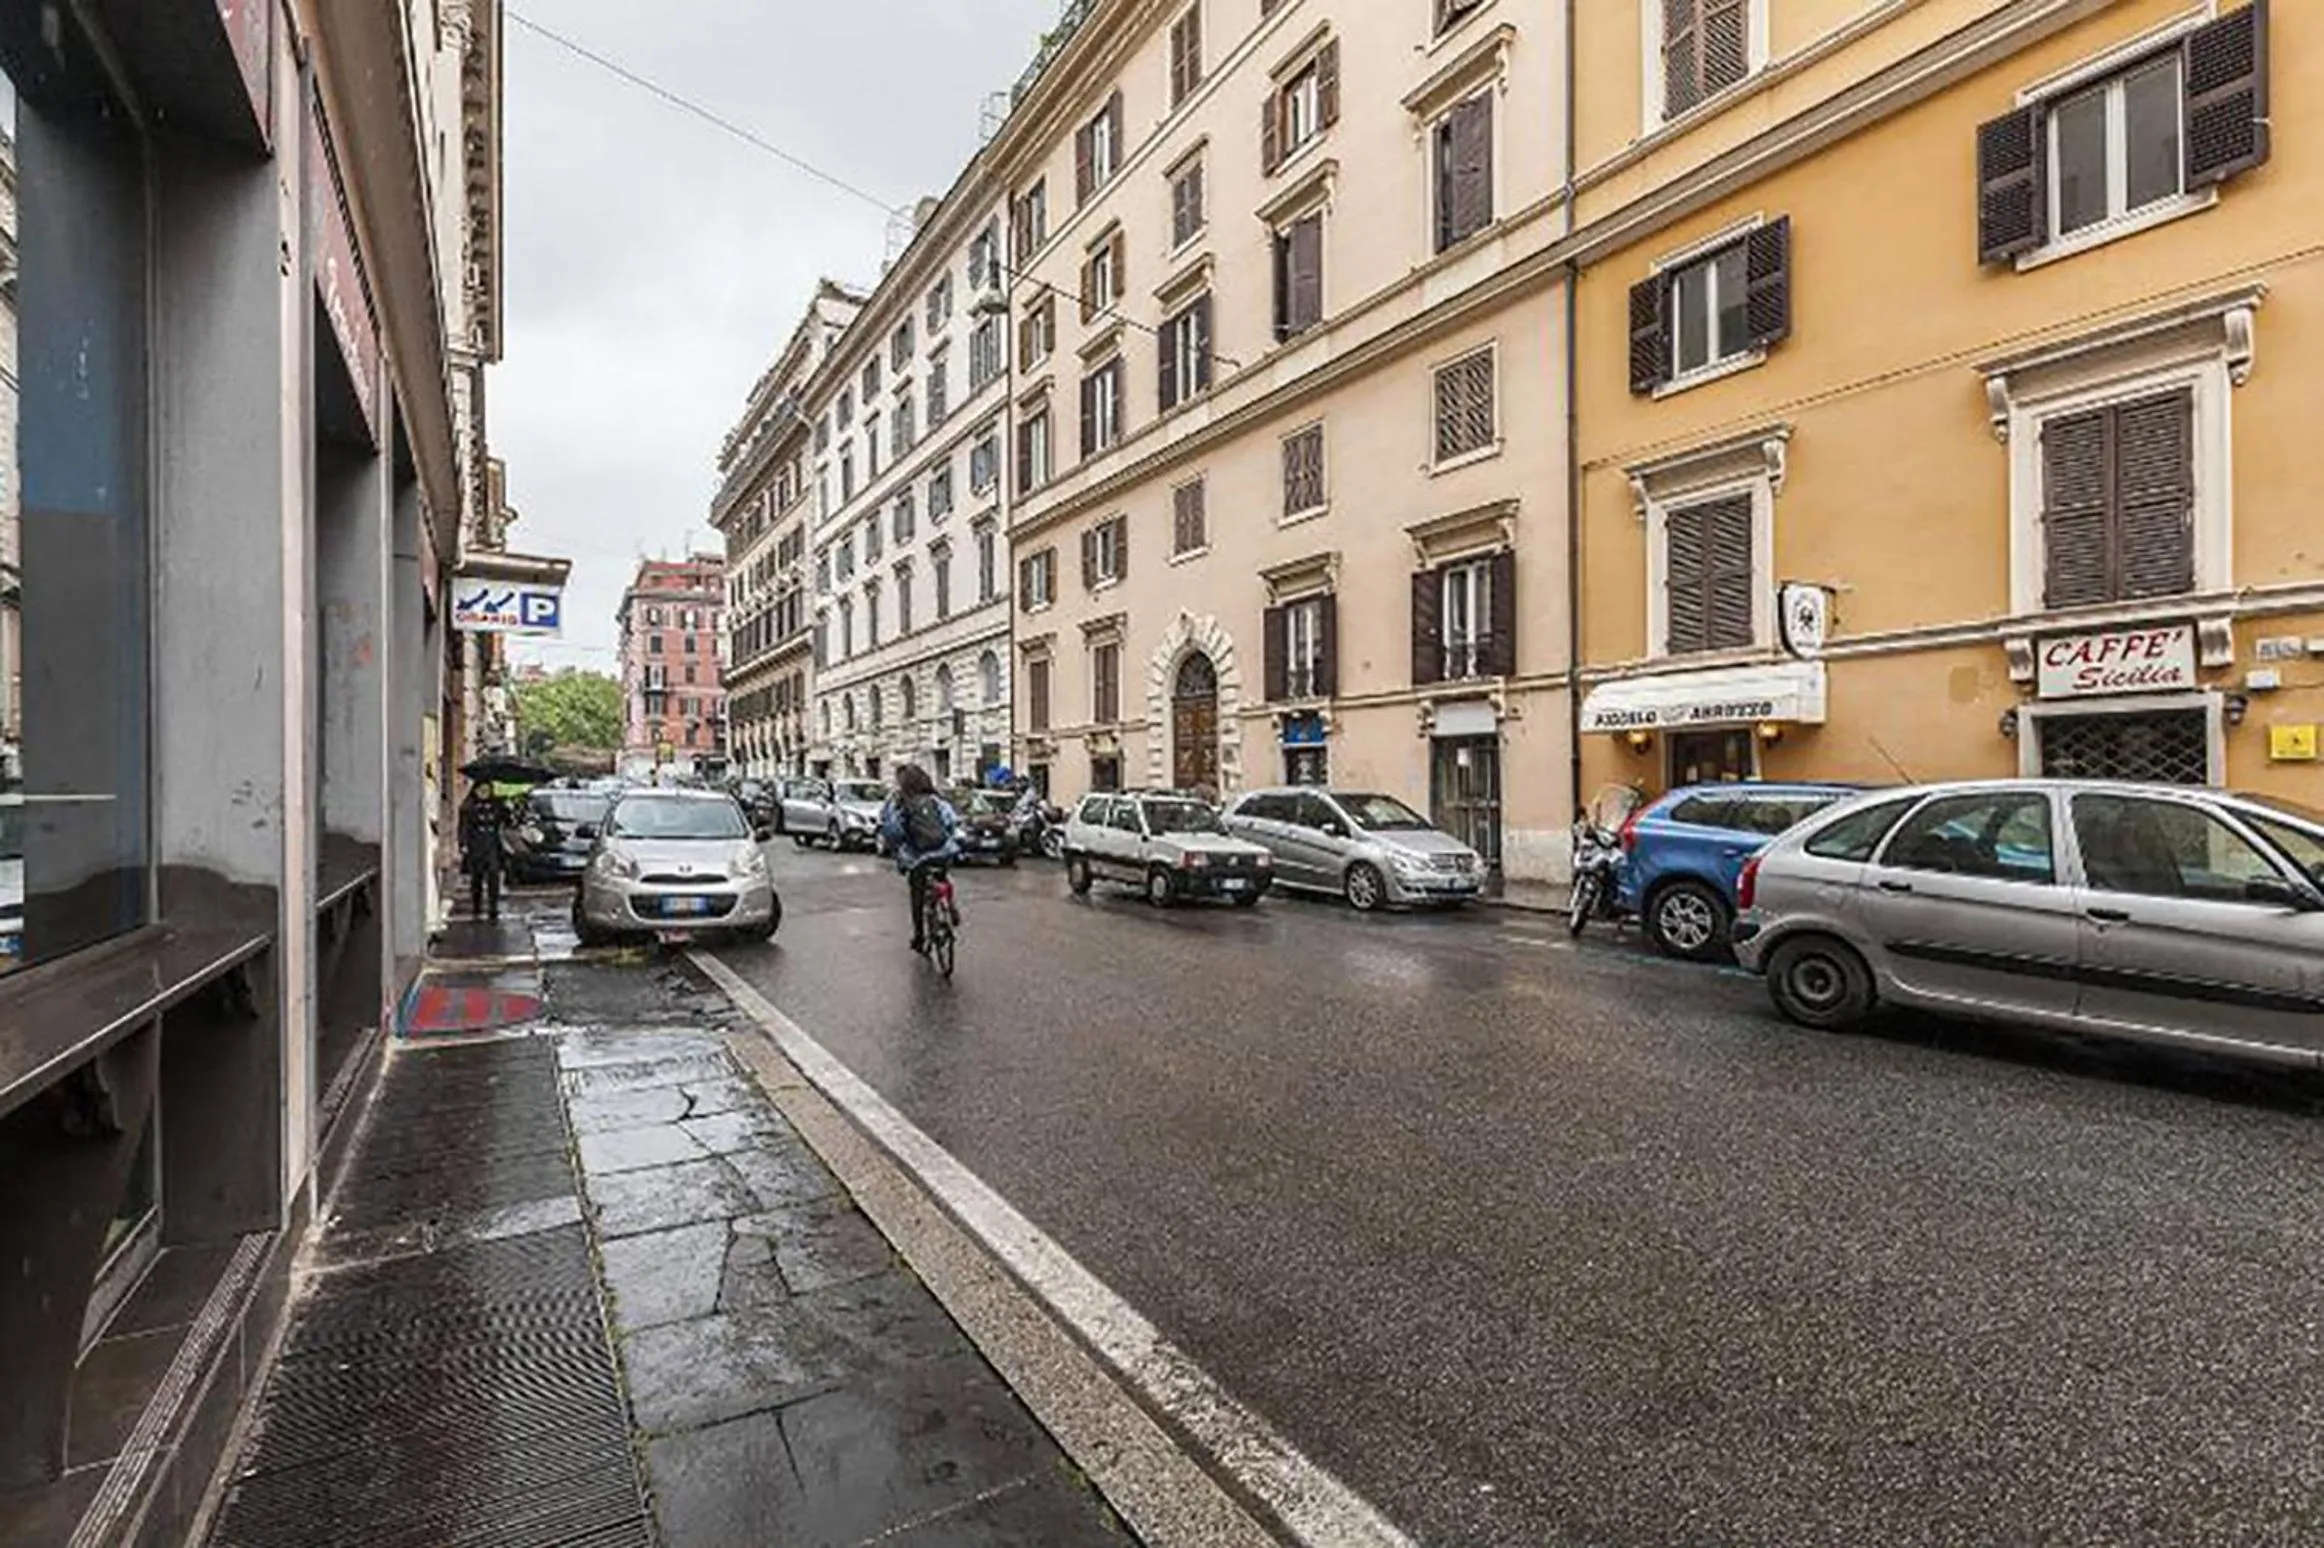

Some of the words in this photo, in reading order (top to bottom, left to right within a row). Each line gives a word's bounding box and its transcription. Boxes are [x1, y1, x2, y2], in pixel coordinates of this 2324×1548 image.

[527, 597, 556, 623] P
[2045, 629, 2183, 667] CAFFE'
[2072, 664, 2181, 690] Sicilia
